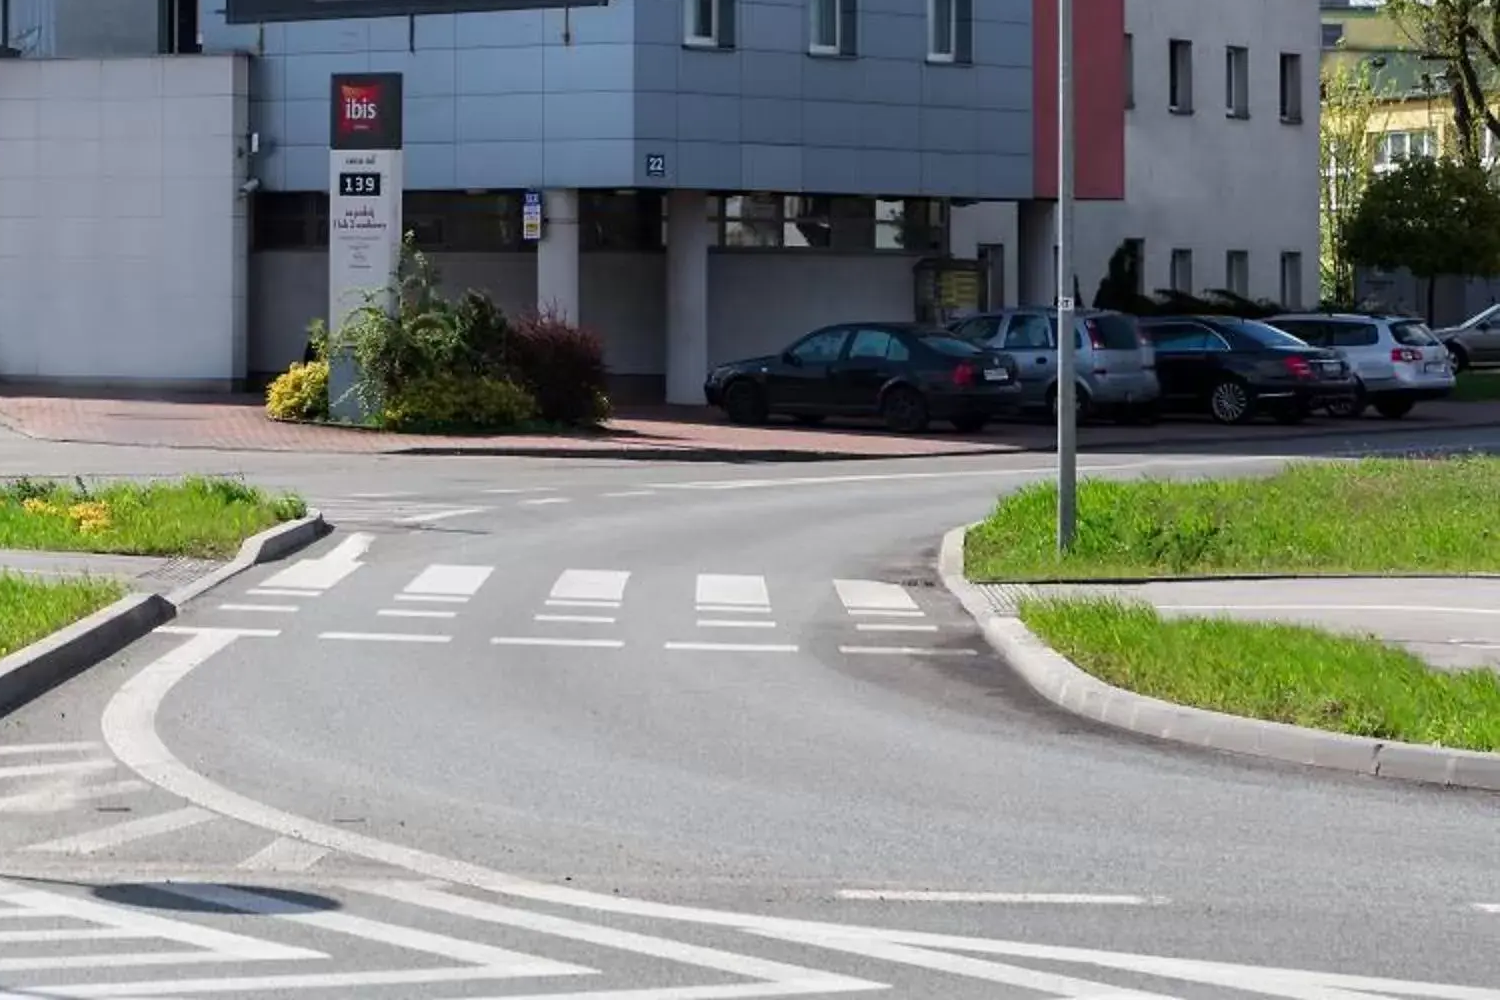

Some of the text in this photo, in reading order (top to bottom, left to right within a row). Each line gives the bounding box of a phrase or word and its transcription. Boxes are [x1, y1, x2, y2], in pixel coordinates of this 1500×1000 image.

[345, 98, 377, 120] ibis
[649, 157, 664, 171] 22
[344, 177, 376, 192] 139
